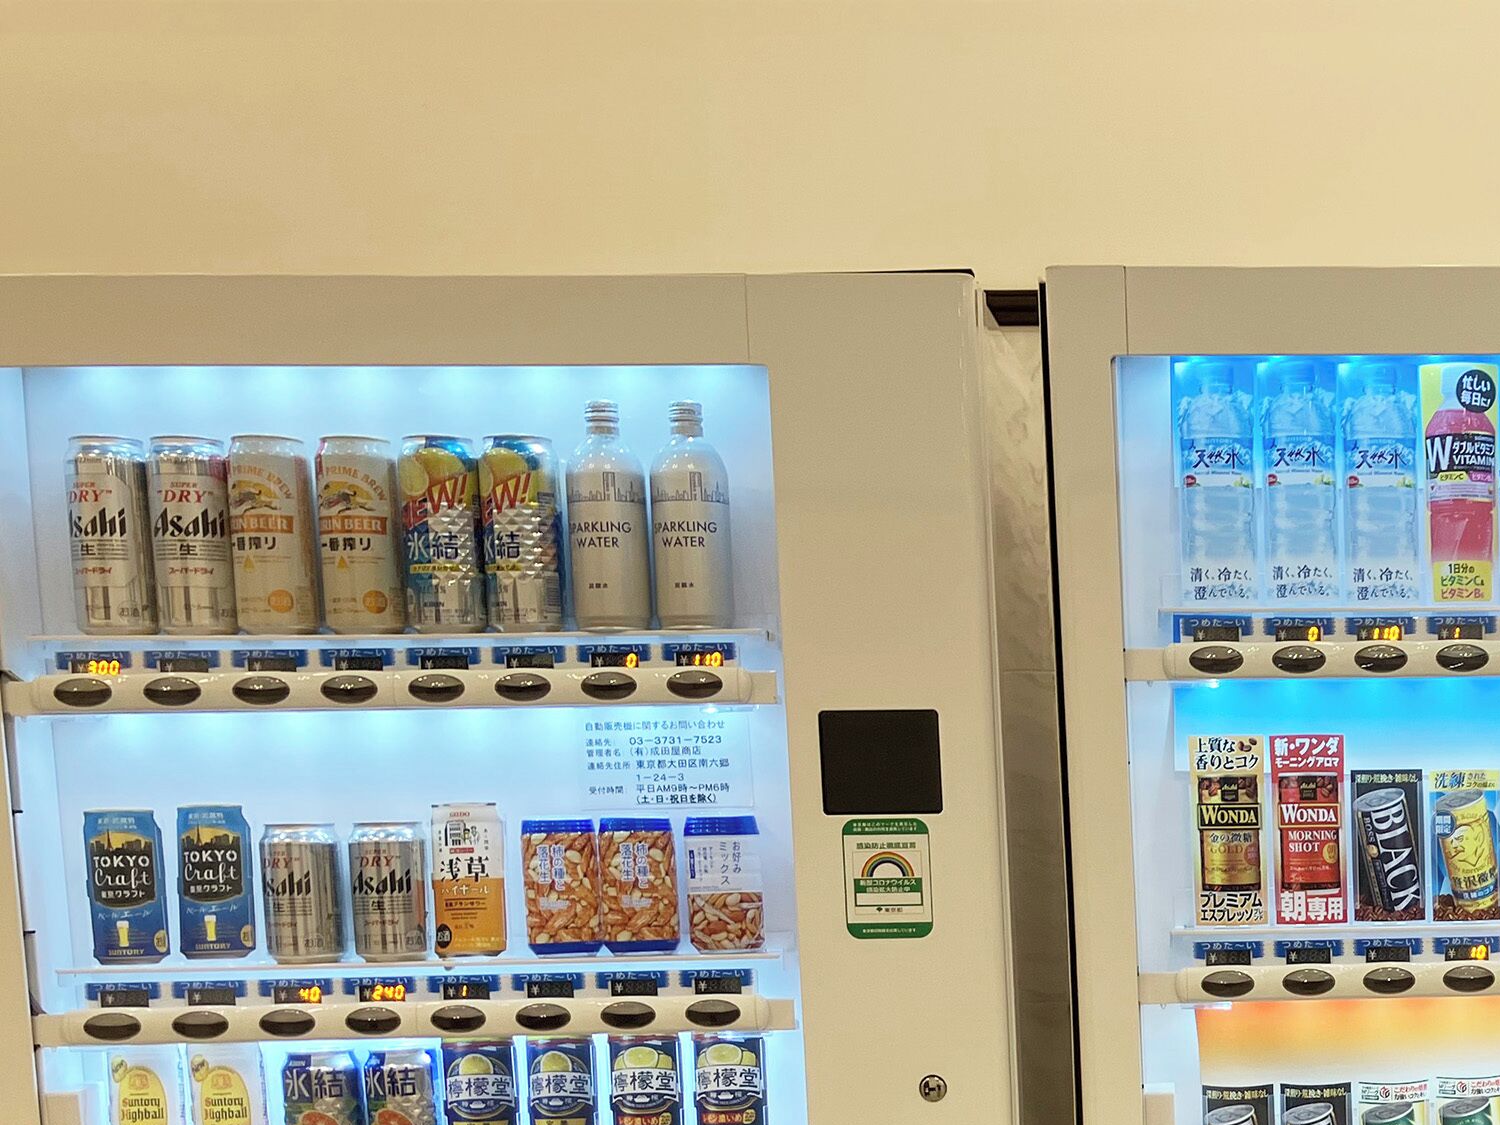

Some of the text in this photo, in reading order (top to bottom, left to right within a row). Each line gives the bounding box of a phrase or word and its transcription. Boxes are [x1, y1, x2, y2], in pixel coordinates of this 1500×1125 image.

[1462, 375, 1491, 391] 忙しい
[1426, 436, 1453, 472] W
[154, 507, 224, 538] Asahi
[81, 544, 96, 556] 生
[408, 532, 459, 560] 氷結
[576, 536, 619, 548] WATER
[662, 536, 705, 548] WATER
[1448, 564, 1474, 574] 1日分の
[88, 660, 119, 675] 300
[585, 720, 725, 731] 自動販売機に関するお問い合わせ
[630, 736, 722, 745] 03-3731-7523
[1196, 738, 1236, 754] 上質な
[1274, 737, 1340, 756] 新・ワンダ
[587, 749, 621, 757] 管理者名
[588, 759, 730, 770] 連絡先住所 東京都大田区南六郷
[1196, 754, 1259, 770] 香りとコク
[1274, 757, 1339, 768] モーニングアロマ
[1434, 772, 1465, 789] 洗練
[1201, 805, 1256, 824] WONDA
[1281, 804, 1336, 823] WONDA
[1289, 831, 1337, 841] MORNING
[1289, 842, 1320, 853] SHOT
[93, 856, 150, 868] TOKYO
[184, 850, 237, 863] TOKYO
[1371, 802, 1421, 912] BLACK
[440, 856, 489, 882] 浅草
[94, 868, 151, 889] Craft
[1200, 893, 1262, 909] プレミアム
[1280, 891, 1343, 922] 朝専用
[1201, 908, 1252, 922] エスプレッソ
[285, 1067, 345, 1100] 氷結
[448, 1077, 512, 1098] 檸檬堂
